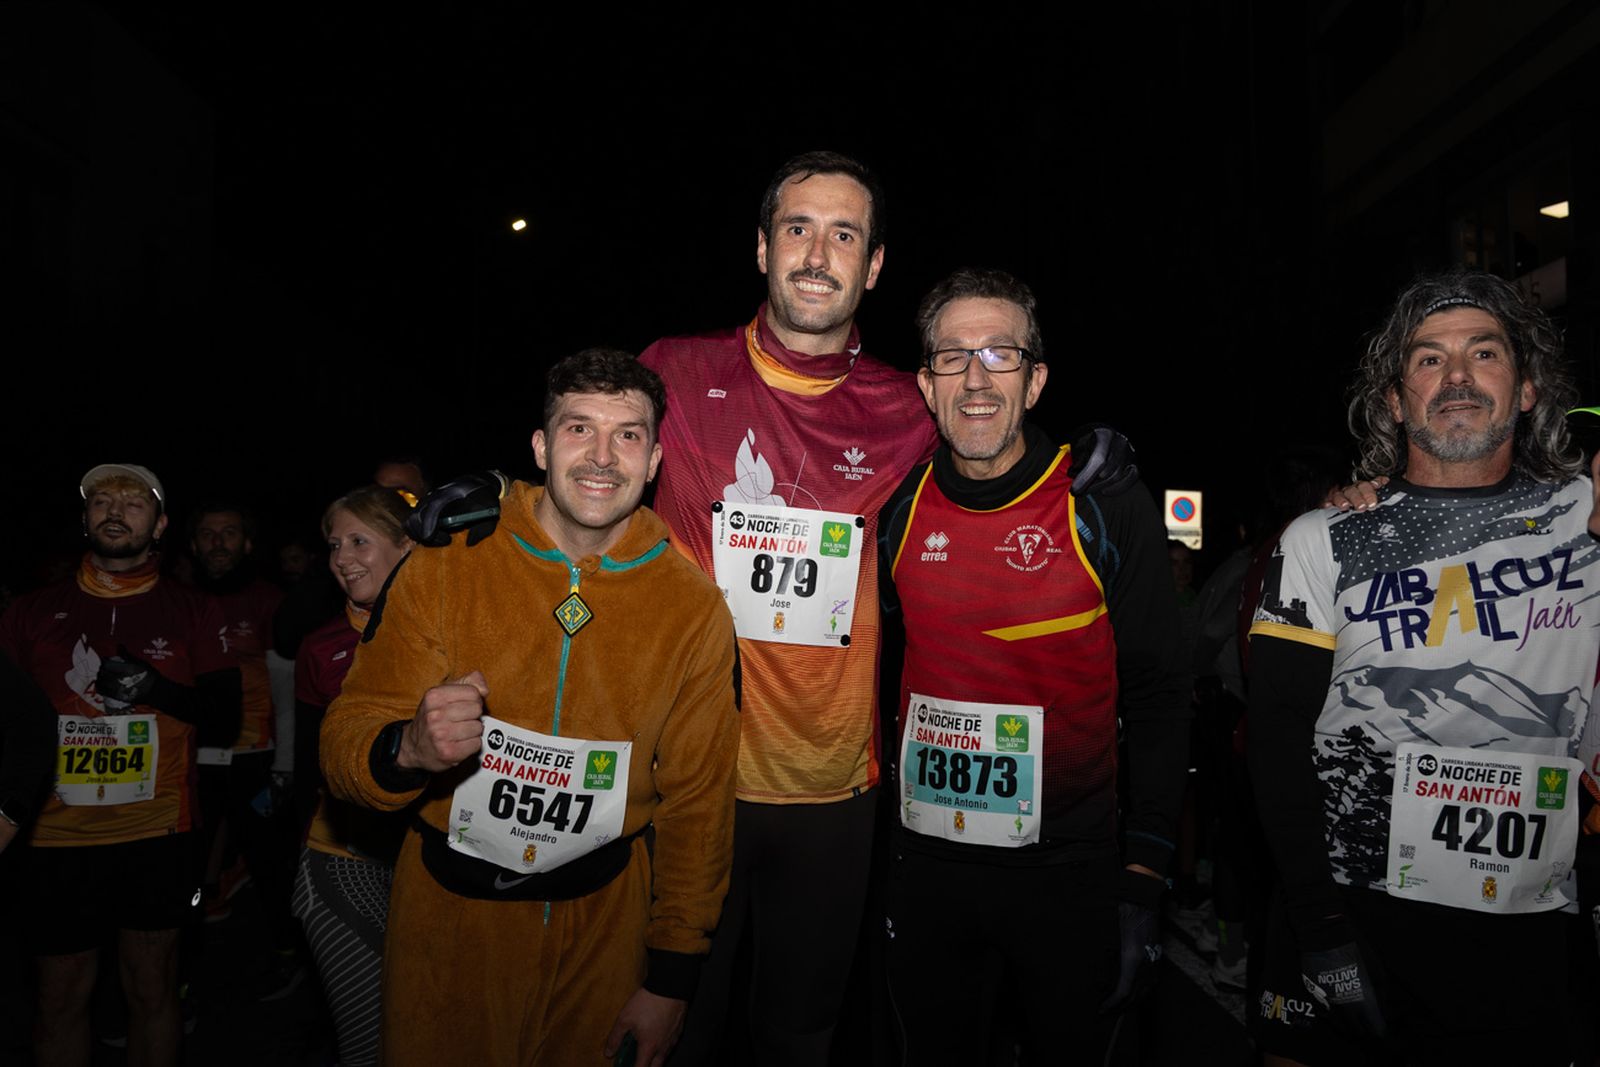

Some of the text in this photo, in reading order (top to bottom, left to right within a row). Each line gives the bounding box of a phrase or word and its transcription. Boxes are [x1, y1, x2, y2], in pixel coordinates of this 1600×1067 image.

[730, 514, 744, 527] 43
[747, 519, 789, 535] NOCHE
[791, 523, 810, 537] DE
[728, 533, 808, 555] SAN ANTÓN
[920, 551, 948, 562] errea
[750, 553, 818, 598] 879
[769, 598, 791, 609] Jose
[1515, 597, 1582, 652] Jaén
[77, 725, 106, 735] NOCHE
[928, 713, 961, 732] NOCHE
[964, 719, 982, 733] DE
[63, 736, 85, 746] SAN
[488, 731, 504, 747] 43
[506, 735, 525, 748] CARRERA
[916, 727, 981, 751] SAN ANTÓN
[63, 747, 144, 775] 12664
[503, 741, 575, 770] NOCHE DE
[1417, 758, 1436, 771] 43
[1441, 757, 1464, 766] CARRERA
[481, 753, 571, 788] SAN ANTÓN
[917, 747, 1018, 799] 13873
[1440, 764, 1522, 787] NOCHE DE
[934, 793, 988, 810] Jose Antonio
[1415, 780, 1521, 809] SAN ANTÓN
[488, 778, 595, 835] 6547
[510, 826, 558, 845] Alejandro
[1431, 804, 1547, 860] 4207
[1469, 858, 1511, 874] Ramon
[1335, 978, 1361, 994] SAN
